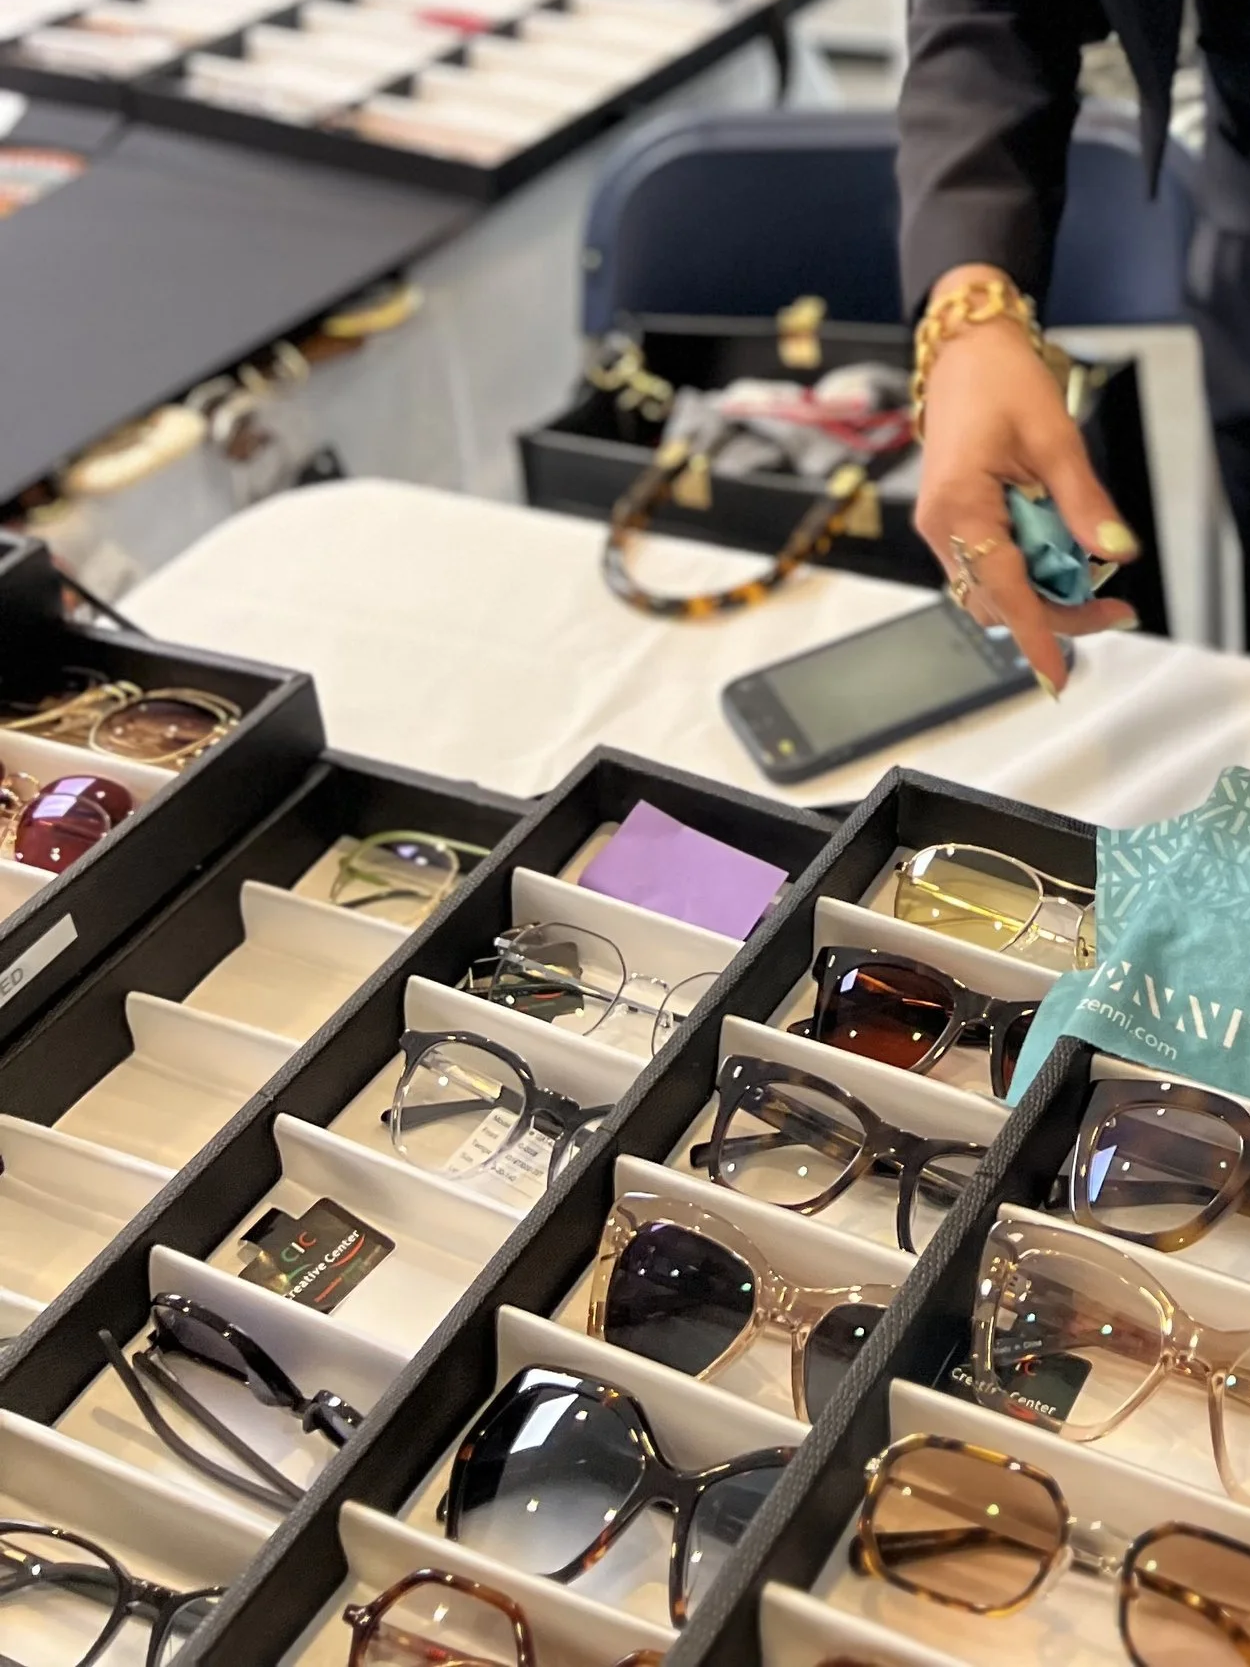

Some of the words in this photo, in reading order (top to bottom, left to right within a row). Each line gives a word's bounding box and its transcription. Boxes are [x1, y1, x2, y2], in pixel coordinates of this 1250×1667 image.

[1076, 998, 1178, 1061] zenni.com
[1088, 960, 1244, 1050] ENNI
[280, 1231, 317, 1263] CIC
[323, 1229, 360, 1264] Center
